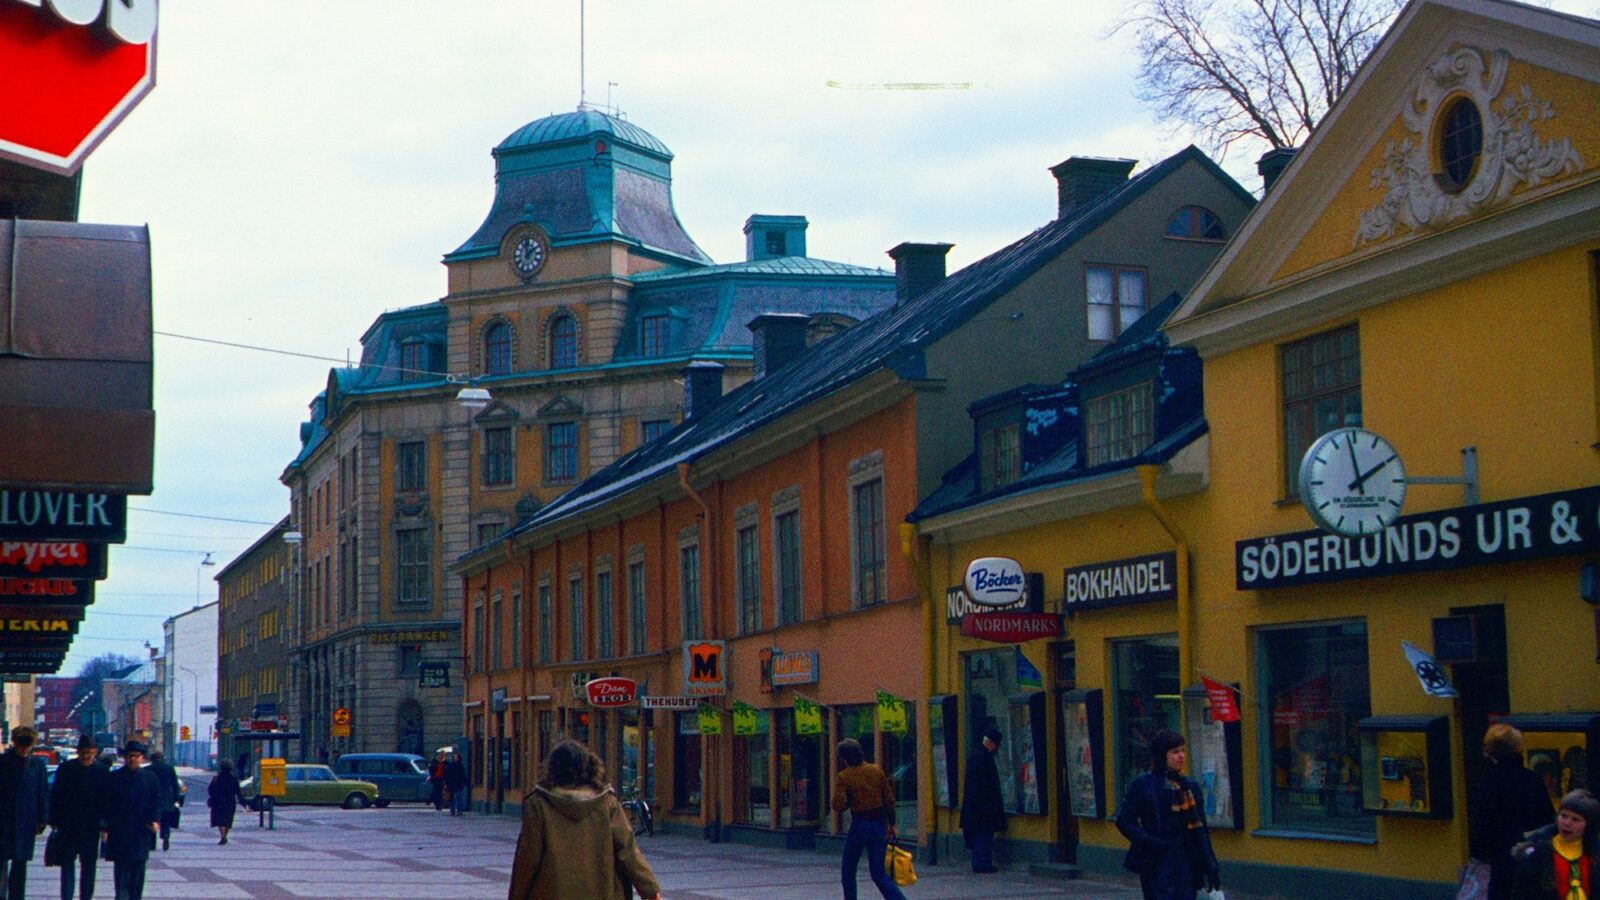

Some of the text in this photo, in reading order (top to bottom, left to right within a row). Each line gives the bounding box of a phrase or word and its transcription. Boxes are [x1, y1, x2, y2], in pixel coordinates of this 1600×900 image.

[0, 491, 112, 526] LOVER
[1242, 499, 1584, 583] SÖDERLUNDS UR &
[971, 568, 1022, 590] Böcker
[1066, 559, 1171, 604] BOKHANDEL
[975, 615, 1057, 634] NORDMARKS
[694, 653, 717, 679] M
[594, 682, 628, 694] Dam
[594, 693, 632, 703] SKOR
[646, 697, 698, 707] THEHUSET
